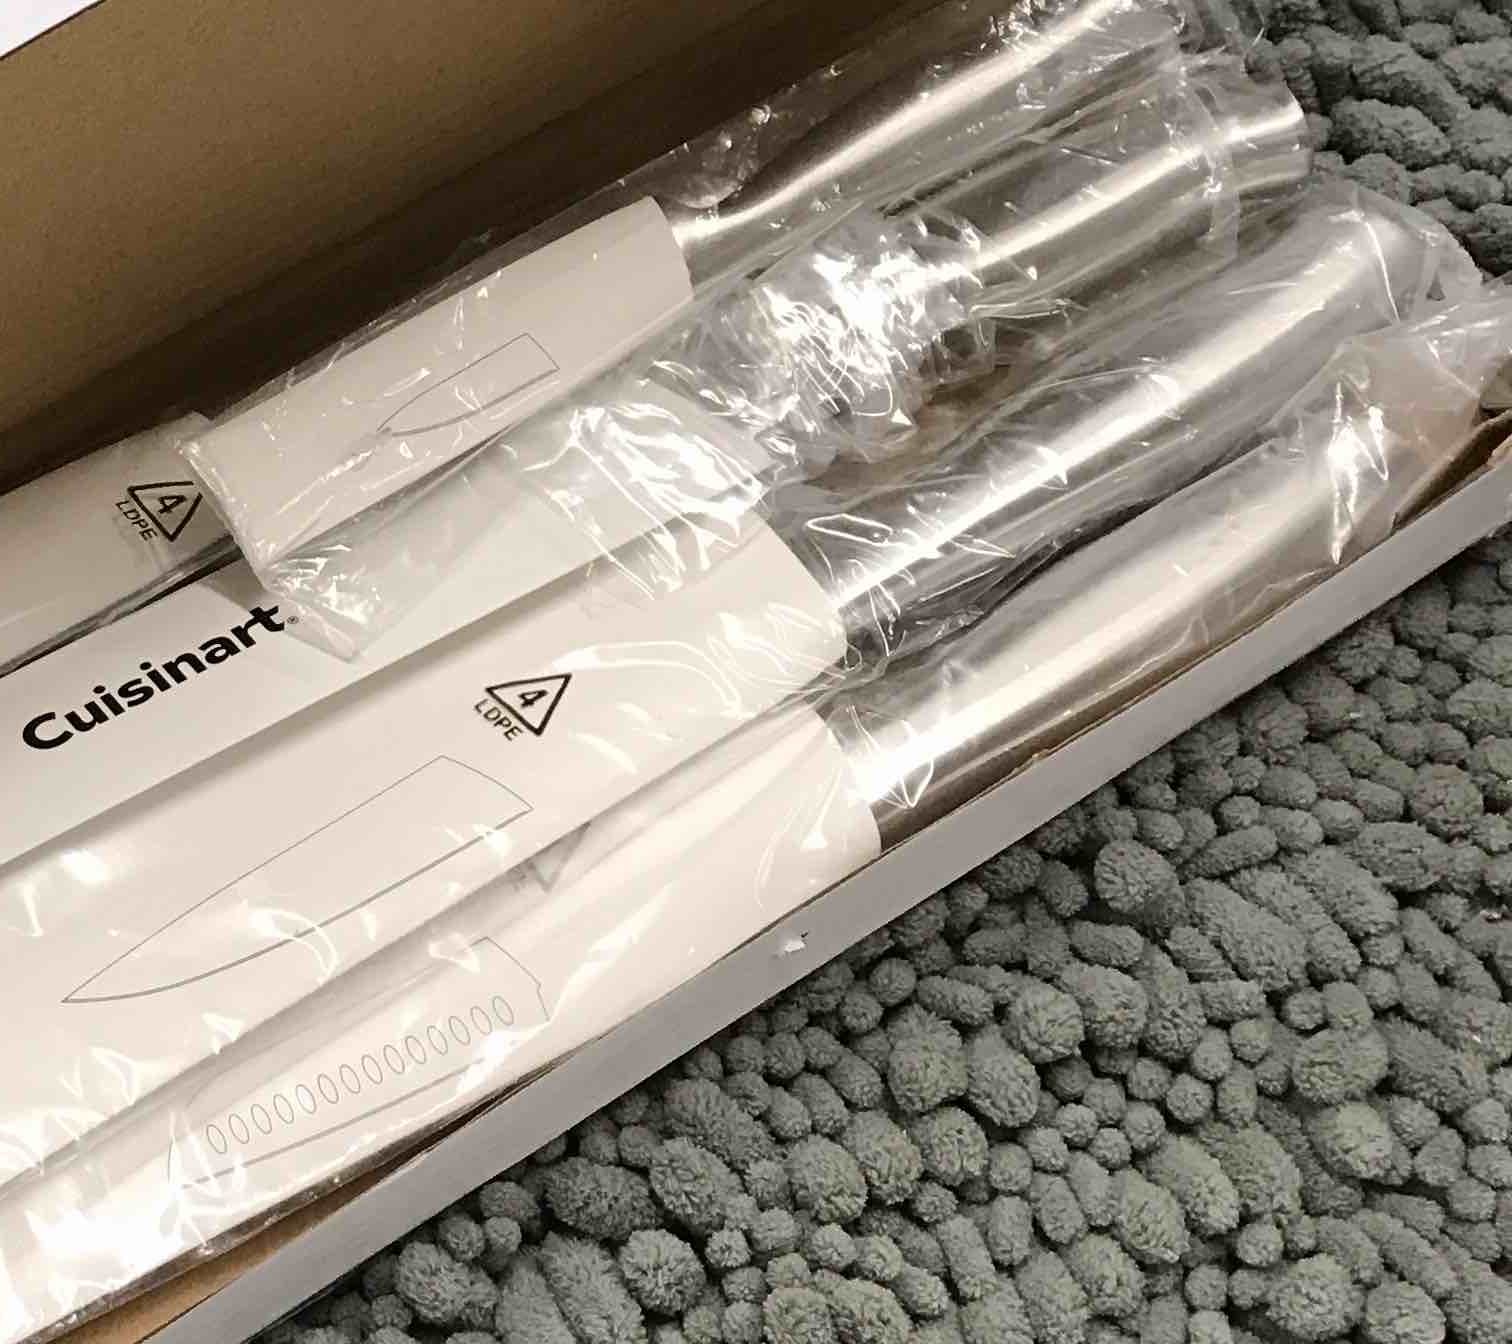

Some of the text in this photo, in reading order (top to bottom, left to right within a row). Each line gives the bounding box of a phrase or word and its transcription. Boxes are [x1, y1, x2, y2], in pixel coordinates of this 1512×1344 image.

[115, 499, 158, 542] LDPE
[22, 604, 285, 750] Cuisinart
[473, 698, 524, 742] LDPE
